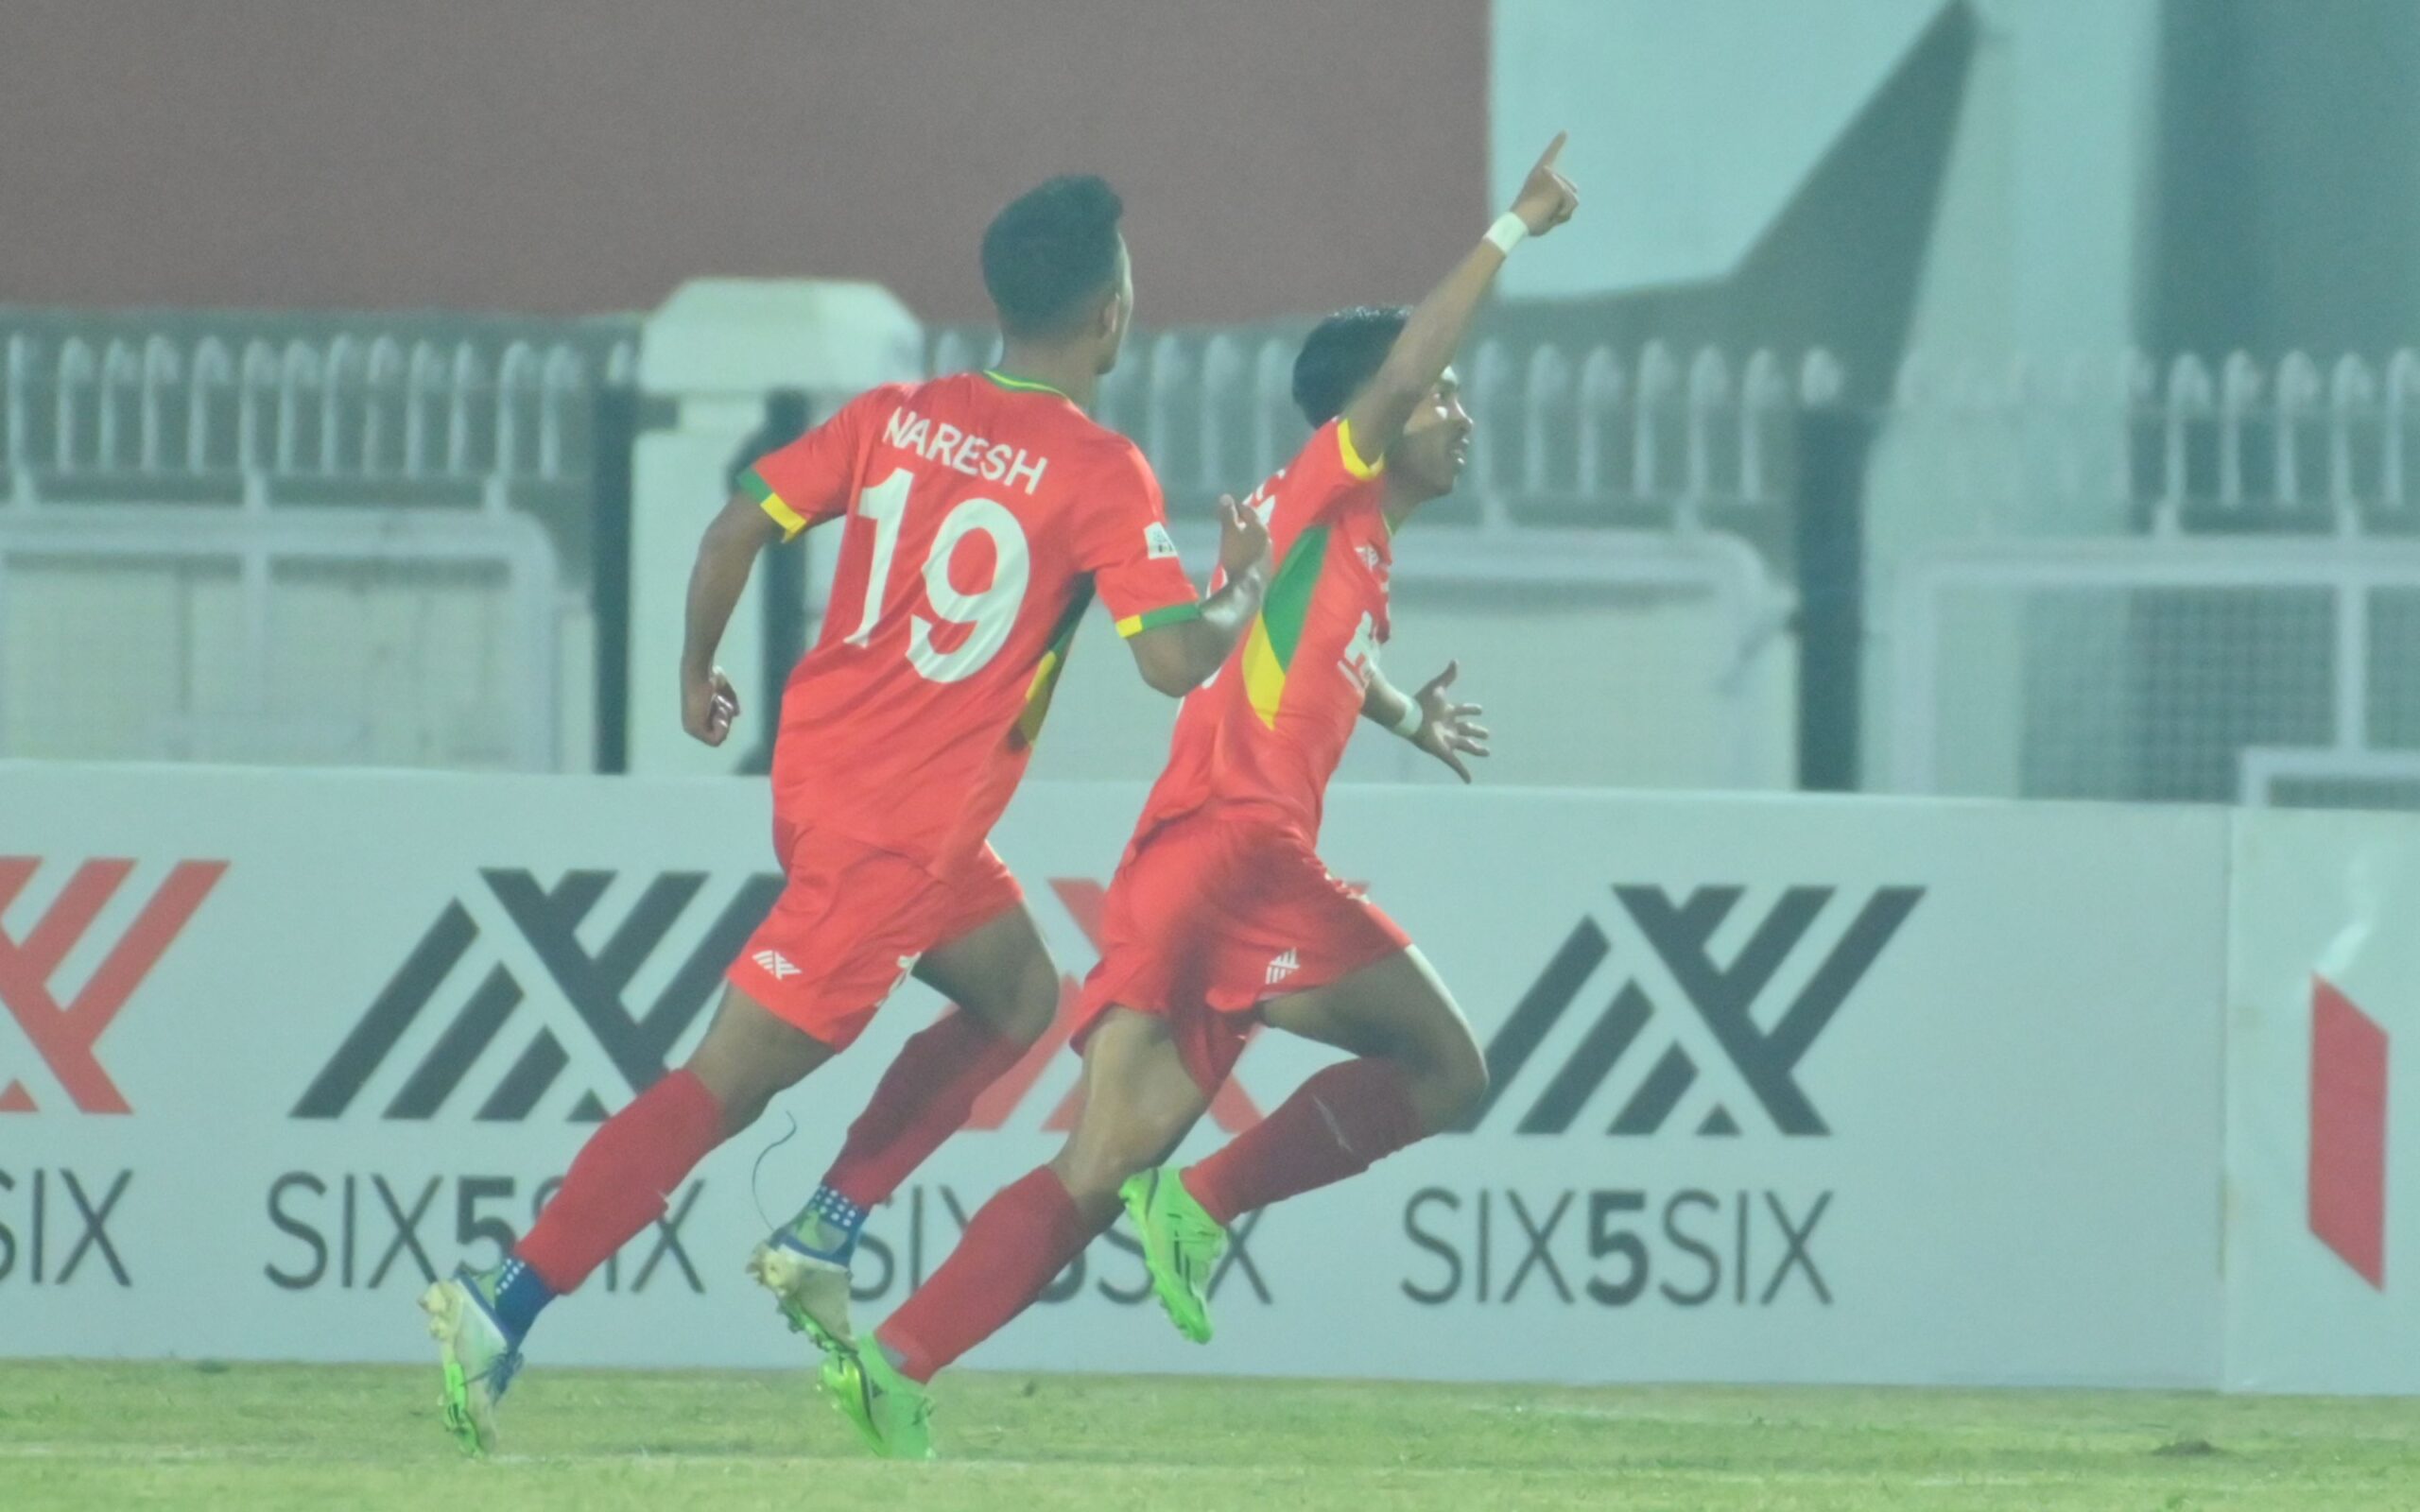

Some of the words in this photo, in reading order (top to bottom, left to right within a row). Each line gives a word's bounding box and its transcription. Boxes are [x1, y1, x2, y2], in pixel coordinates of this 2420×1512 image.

[882, 406, 1047, 494] NARESH
[843, 467, 1030, 682] 19
[264, 1171, 706, 1294] SIX5X
[1400, 1186, 1834, 1307] SIX5SIX
